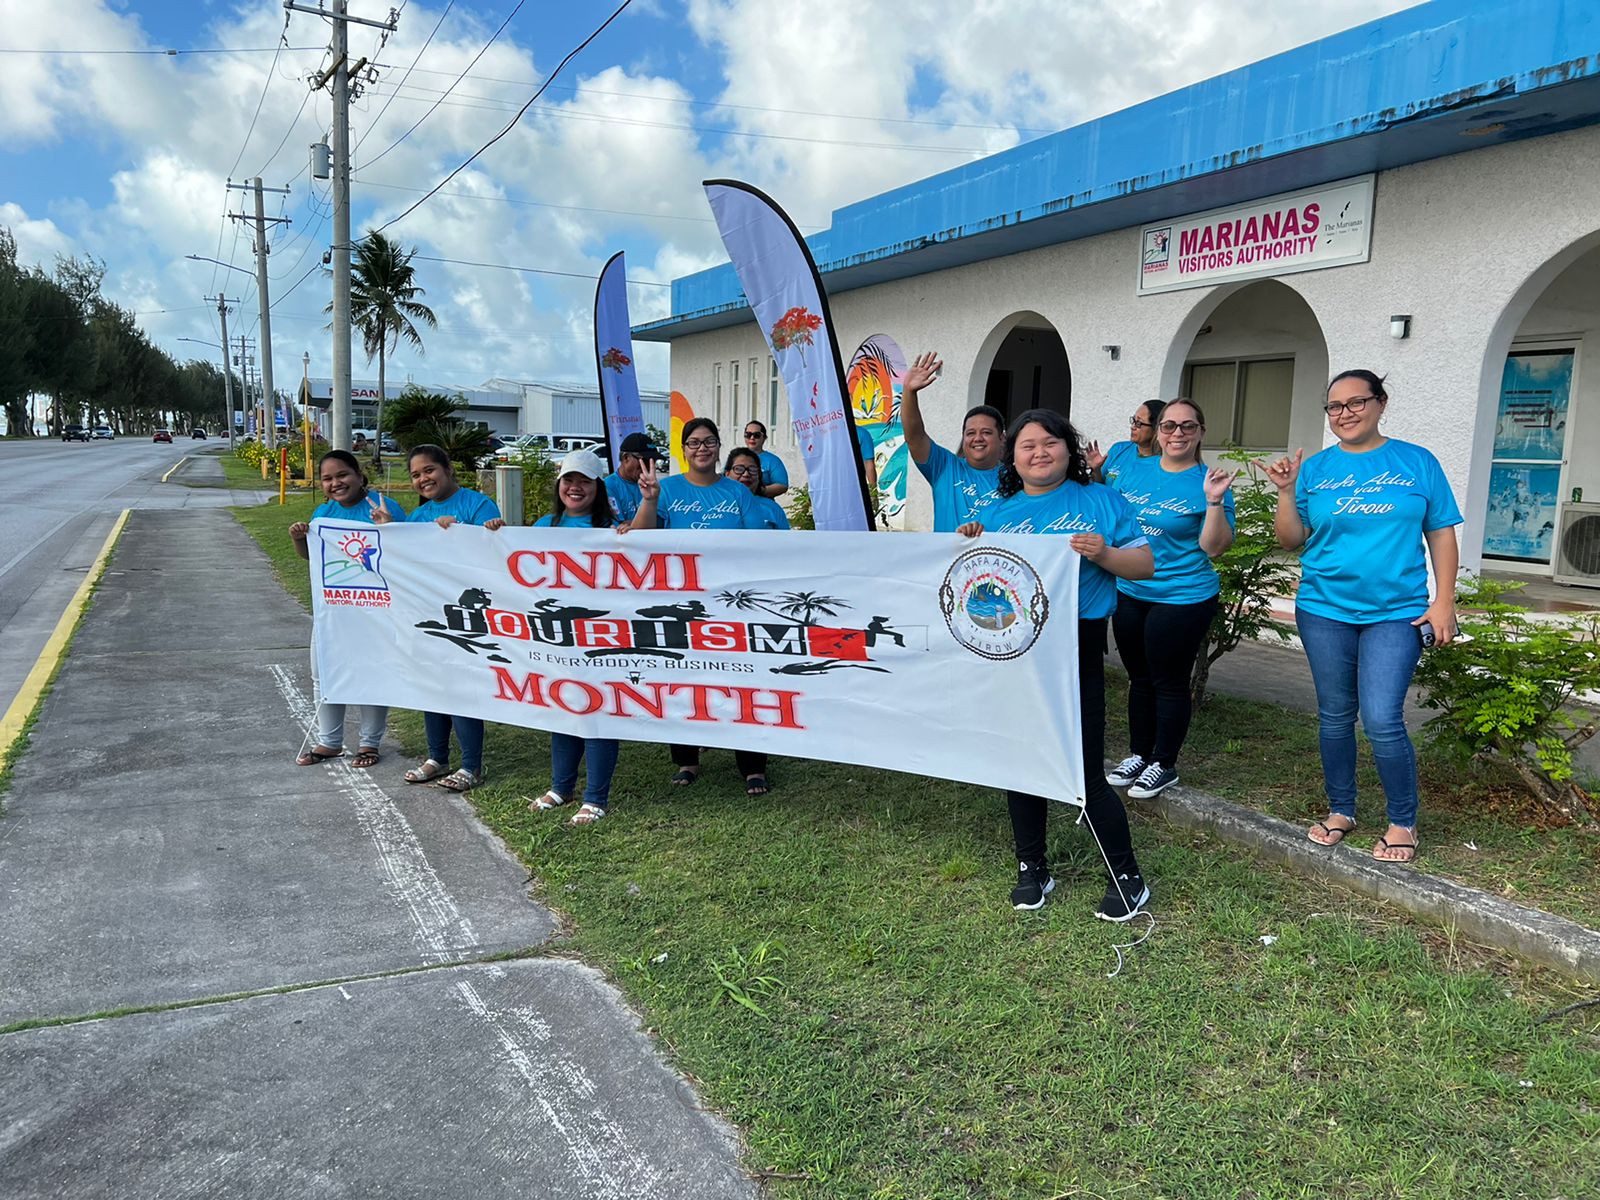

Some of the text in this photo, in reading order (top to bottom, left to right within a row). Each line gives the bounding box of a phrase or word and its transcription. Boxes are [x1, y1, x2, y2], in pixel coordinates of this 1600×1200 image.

[1179, 203, 1320, 257] MARIANAS
[1179, 235, 1318, 274] VISITORS AUTHORITY
[792, 418, 811, 433] The
[1308, 470, 1416, 493] Hafa Adai
[1353, 485, 1384, 497] yan
[667, 499, 741, 515] Hafa Ada
[1139, 507, 1162, 517] yan
[1150, 497, 1197, 515] Adai
[1332, 496, 1396, 516] Tirow
[701, 513, 724, 522] yan
[1040, 512, 1097, 534] Adai
[506, 550, 705, 592] CNMI
[964, 556, 1021, 577] HAFA ADAI
[323, 588, 392, 602] MARIANAS
[355, 600, 392, 608] AUTHORITY
[449, 605, 804, 655] TOURISM
[968, 635, 1014, 653] TIROW
[529, 651, 755, 673] IS EVERYBODY'S BUSINESS
[489, 665, 806, 729] MONTH
